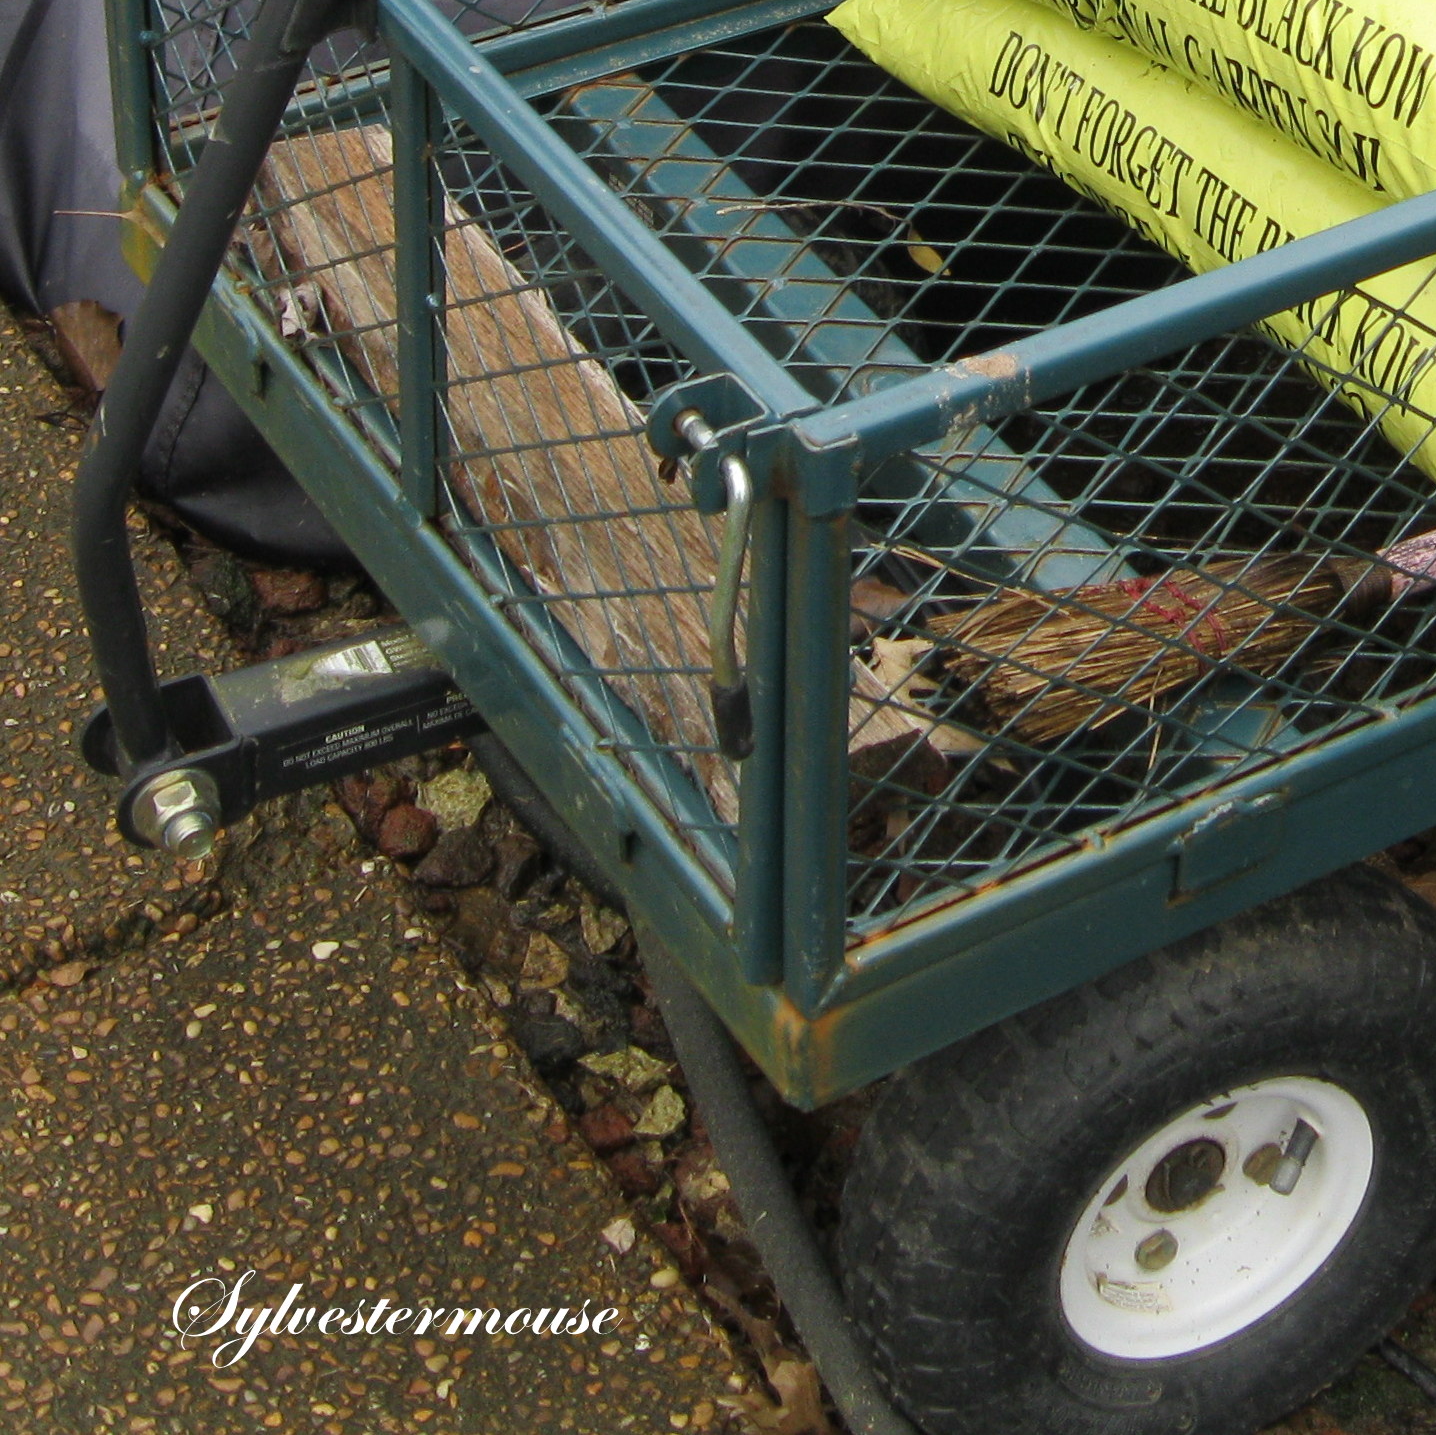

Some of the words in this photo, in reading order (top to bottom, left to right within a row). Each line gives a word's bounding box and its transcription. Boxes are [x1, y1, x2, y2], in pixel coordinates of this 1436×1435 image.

[988, 29, 1083, 136] DON'T
[1074, 86, 1194, 218] FORGET
[1193, 167, 1259, 264] THE
[325, 724, 365, 745] CAUTION
